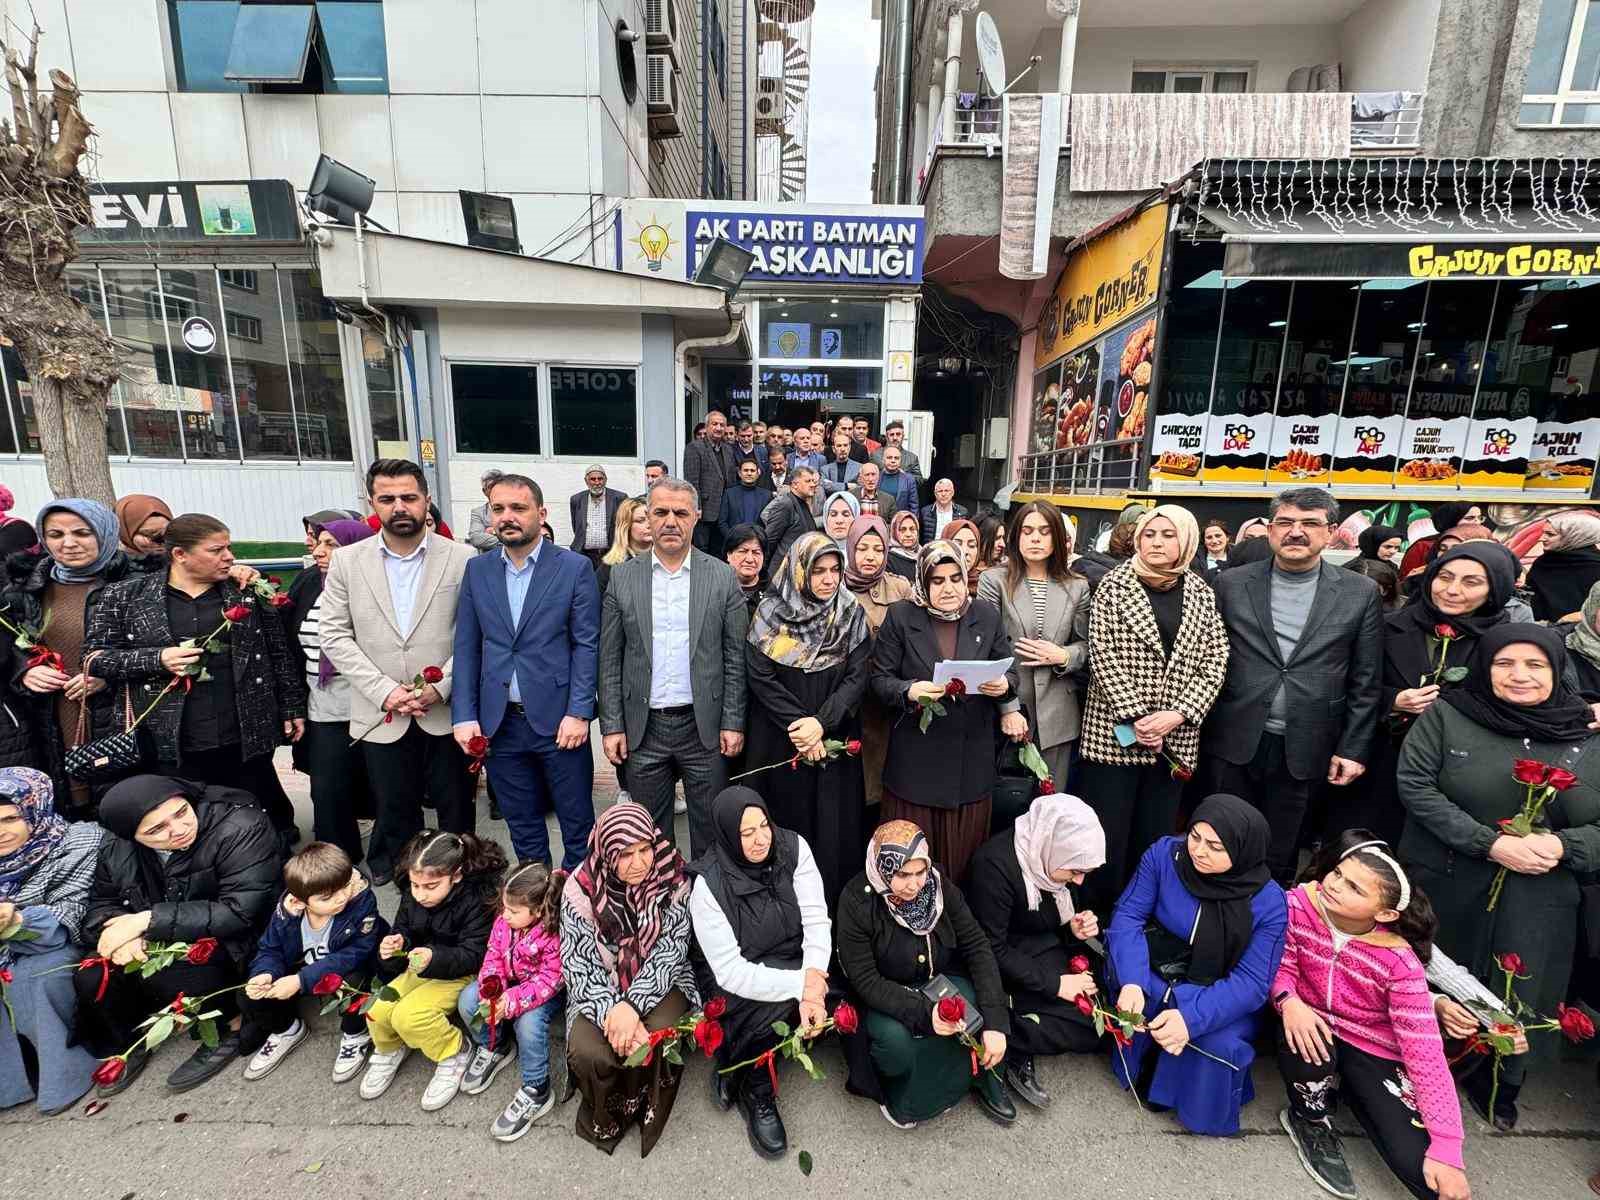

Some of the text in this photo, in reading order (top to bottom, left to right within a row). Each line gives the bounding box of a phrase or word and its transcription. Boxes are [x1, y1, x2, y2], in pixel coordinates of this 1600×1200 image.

[695, 218, 730, 239] AK
[813, 221, 916, 244] BATMAN
[748, 245, 914, 276] AŞKANLIĞI
[1409, 245, 1504, 278] CAJUN
[1094, 259, 1148, 325] CORNER
[1161, 425, 1202, 436] CHICKEN
[1224, 424, 1255, 440] FOOD
[1292, 424, 1320, 434] CAJUN
[1354, 426, 1385, 443] FOOD
[1416, 427, 1441, 436] CAJUN
[1179, 437, 1200, 448] TACO
[1290, 434, 1320, 446] WINGS
[1485, 428, 1517, 445] FOOD
[1223, 438, 1251, 450] LOVE
[1357, 440, 1382, 454] ART
[1413, 444, 1438, 454] TAVUK
[1483, 443, 1511, 455] LOVE
[1548, 446, 1578, 457] ROLL
